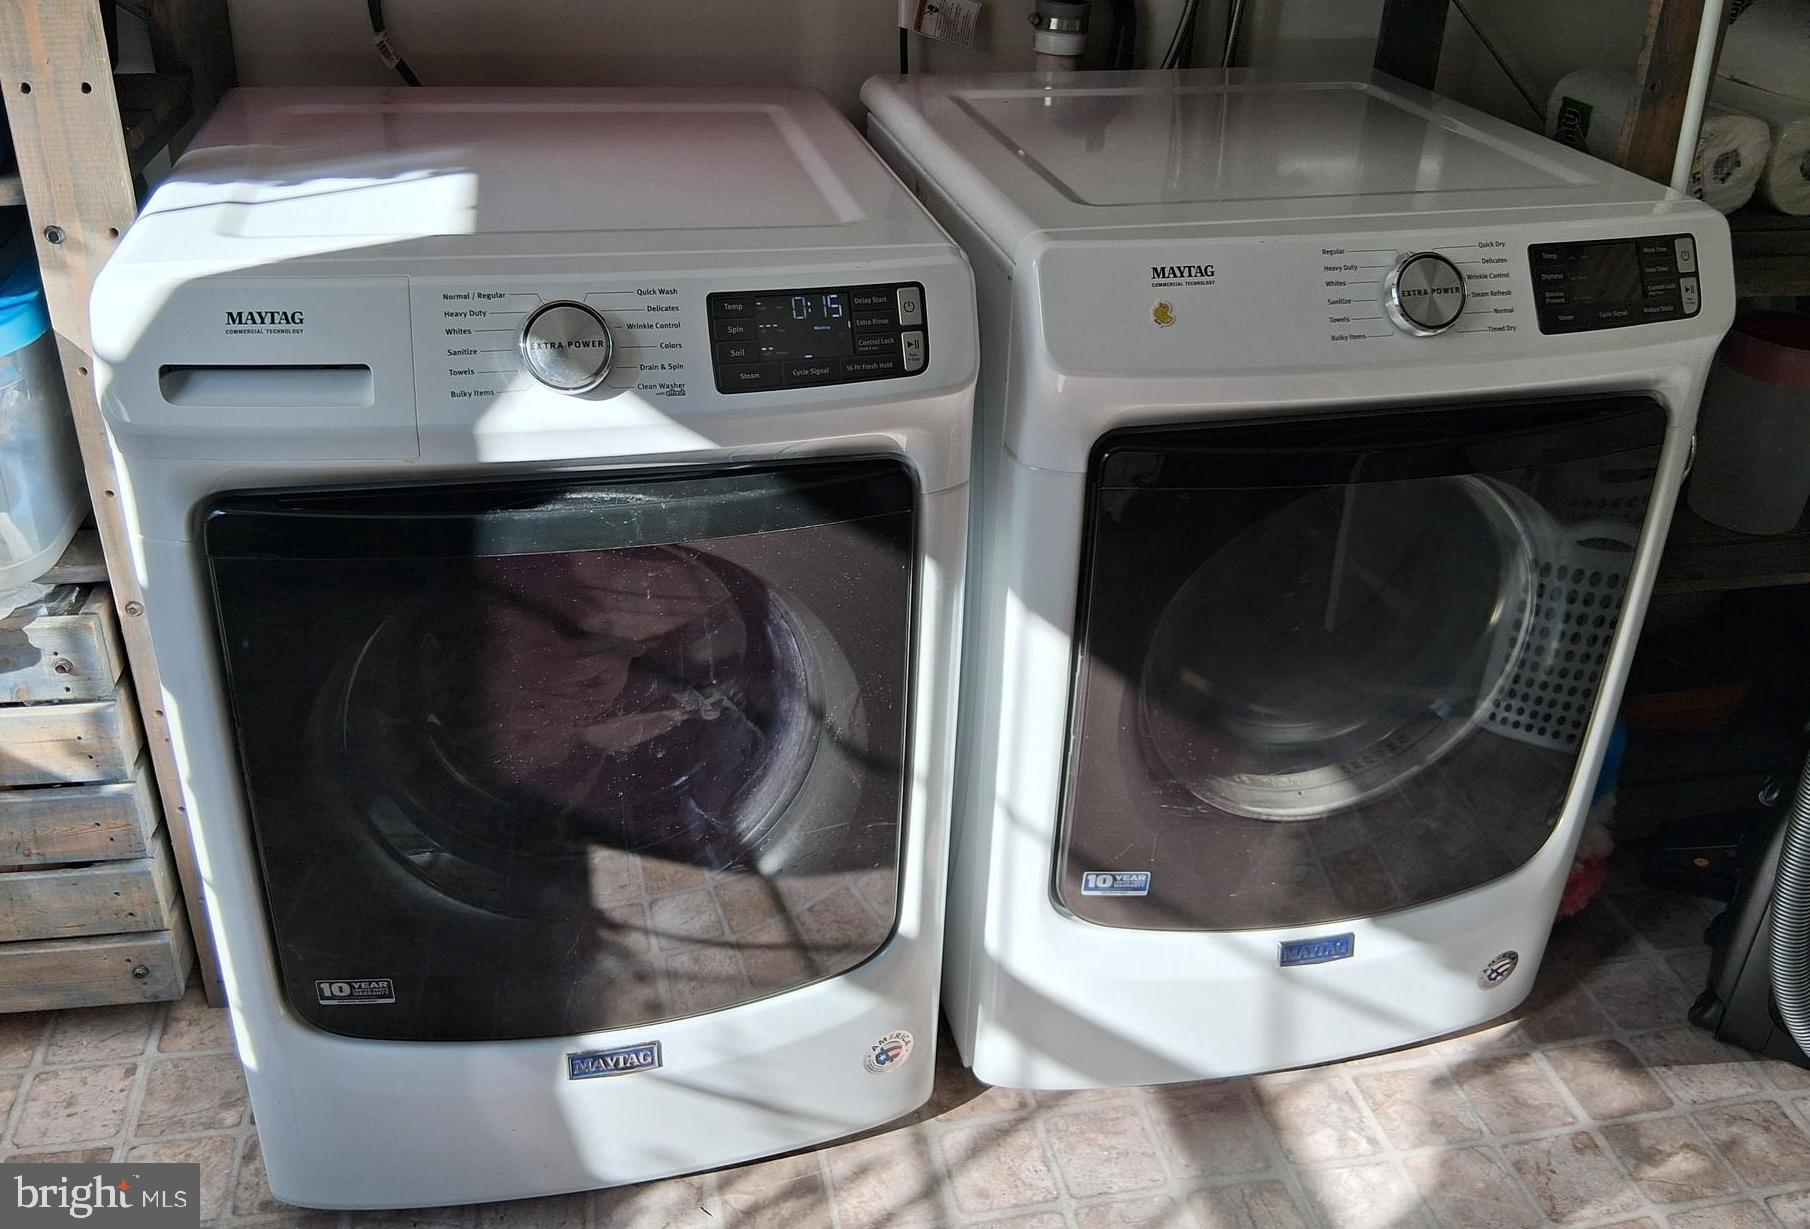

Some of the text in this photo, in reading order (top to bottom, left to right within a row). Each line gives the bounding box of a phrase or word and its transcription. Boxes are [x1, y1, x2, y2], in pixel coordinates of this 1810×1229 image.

[1477, 240, 1506, 249] Quick Dry
[1321, 248, 1345, 256] Regular
[1151, 265, 1215, 280] MAYTAG
[1323, 264, 1358, 273] Heavy Duty
[1466, 273, 1488, 281] Wrinkle
[1325, 280, 1347, 288] Whites
[442, 292, 470, 300] Normal
[477, 290, 506, 301] Regular
[636, 288, 678, 296] Quick Wash
[1401, 286, 1460, 298] EXTRA POWER
[1471, 289, 1512, 299] Steam Refresh
[854, 296, 887, 305] Delay Start
[1327, 298, 1352, 306] Sanitize
[646, 304, 680, 312] Delicates
[724, 303, 744, 312] Temp
[1493, 306, 1514, 314] Normal
[225, 310, 304, 325] MAYTAG
[444, 309, 488, 319] Heavy Duty
[856, 318, 889, 327] Extra Rinse
[1329, 316, 1350, 324] Towels
[626, 321, 681, 331] Wrinkle Control
[727, 325, 744, 335] Spin
[1488, 324, 1517, 333] Timed Dry
[445, 328, 472, 336] Whites
[858, 337, 895, 347] Control Lock
[1331, 334, 1348, 342] Bulky
[530, 339, 604, 350] EXTRA POWER
[659, 341, 683, 350] Colors
[447, 348, 478, 357] Sanitize
[730, 348, 745, 358] Soil
[639, 361, 684, 372] Drain & Spin
[880, 362, 893, 370] Hold
[449, 368, 475, 377] Towels
[740, 372, 760, 380] Steam
[792, 367, 830, 377] Cycle Signal
[637, 381, 685, 391] Clean Washer
[450, 389, 495, 399] Bulky Items
[1087, 874, 1114, 888] 10
[320, 981, 388, 997] 10 YEAR
[573, 1051, 653, 1075] MAYTAG
